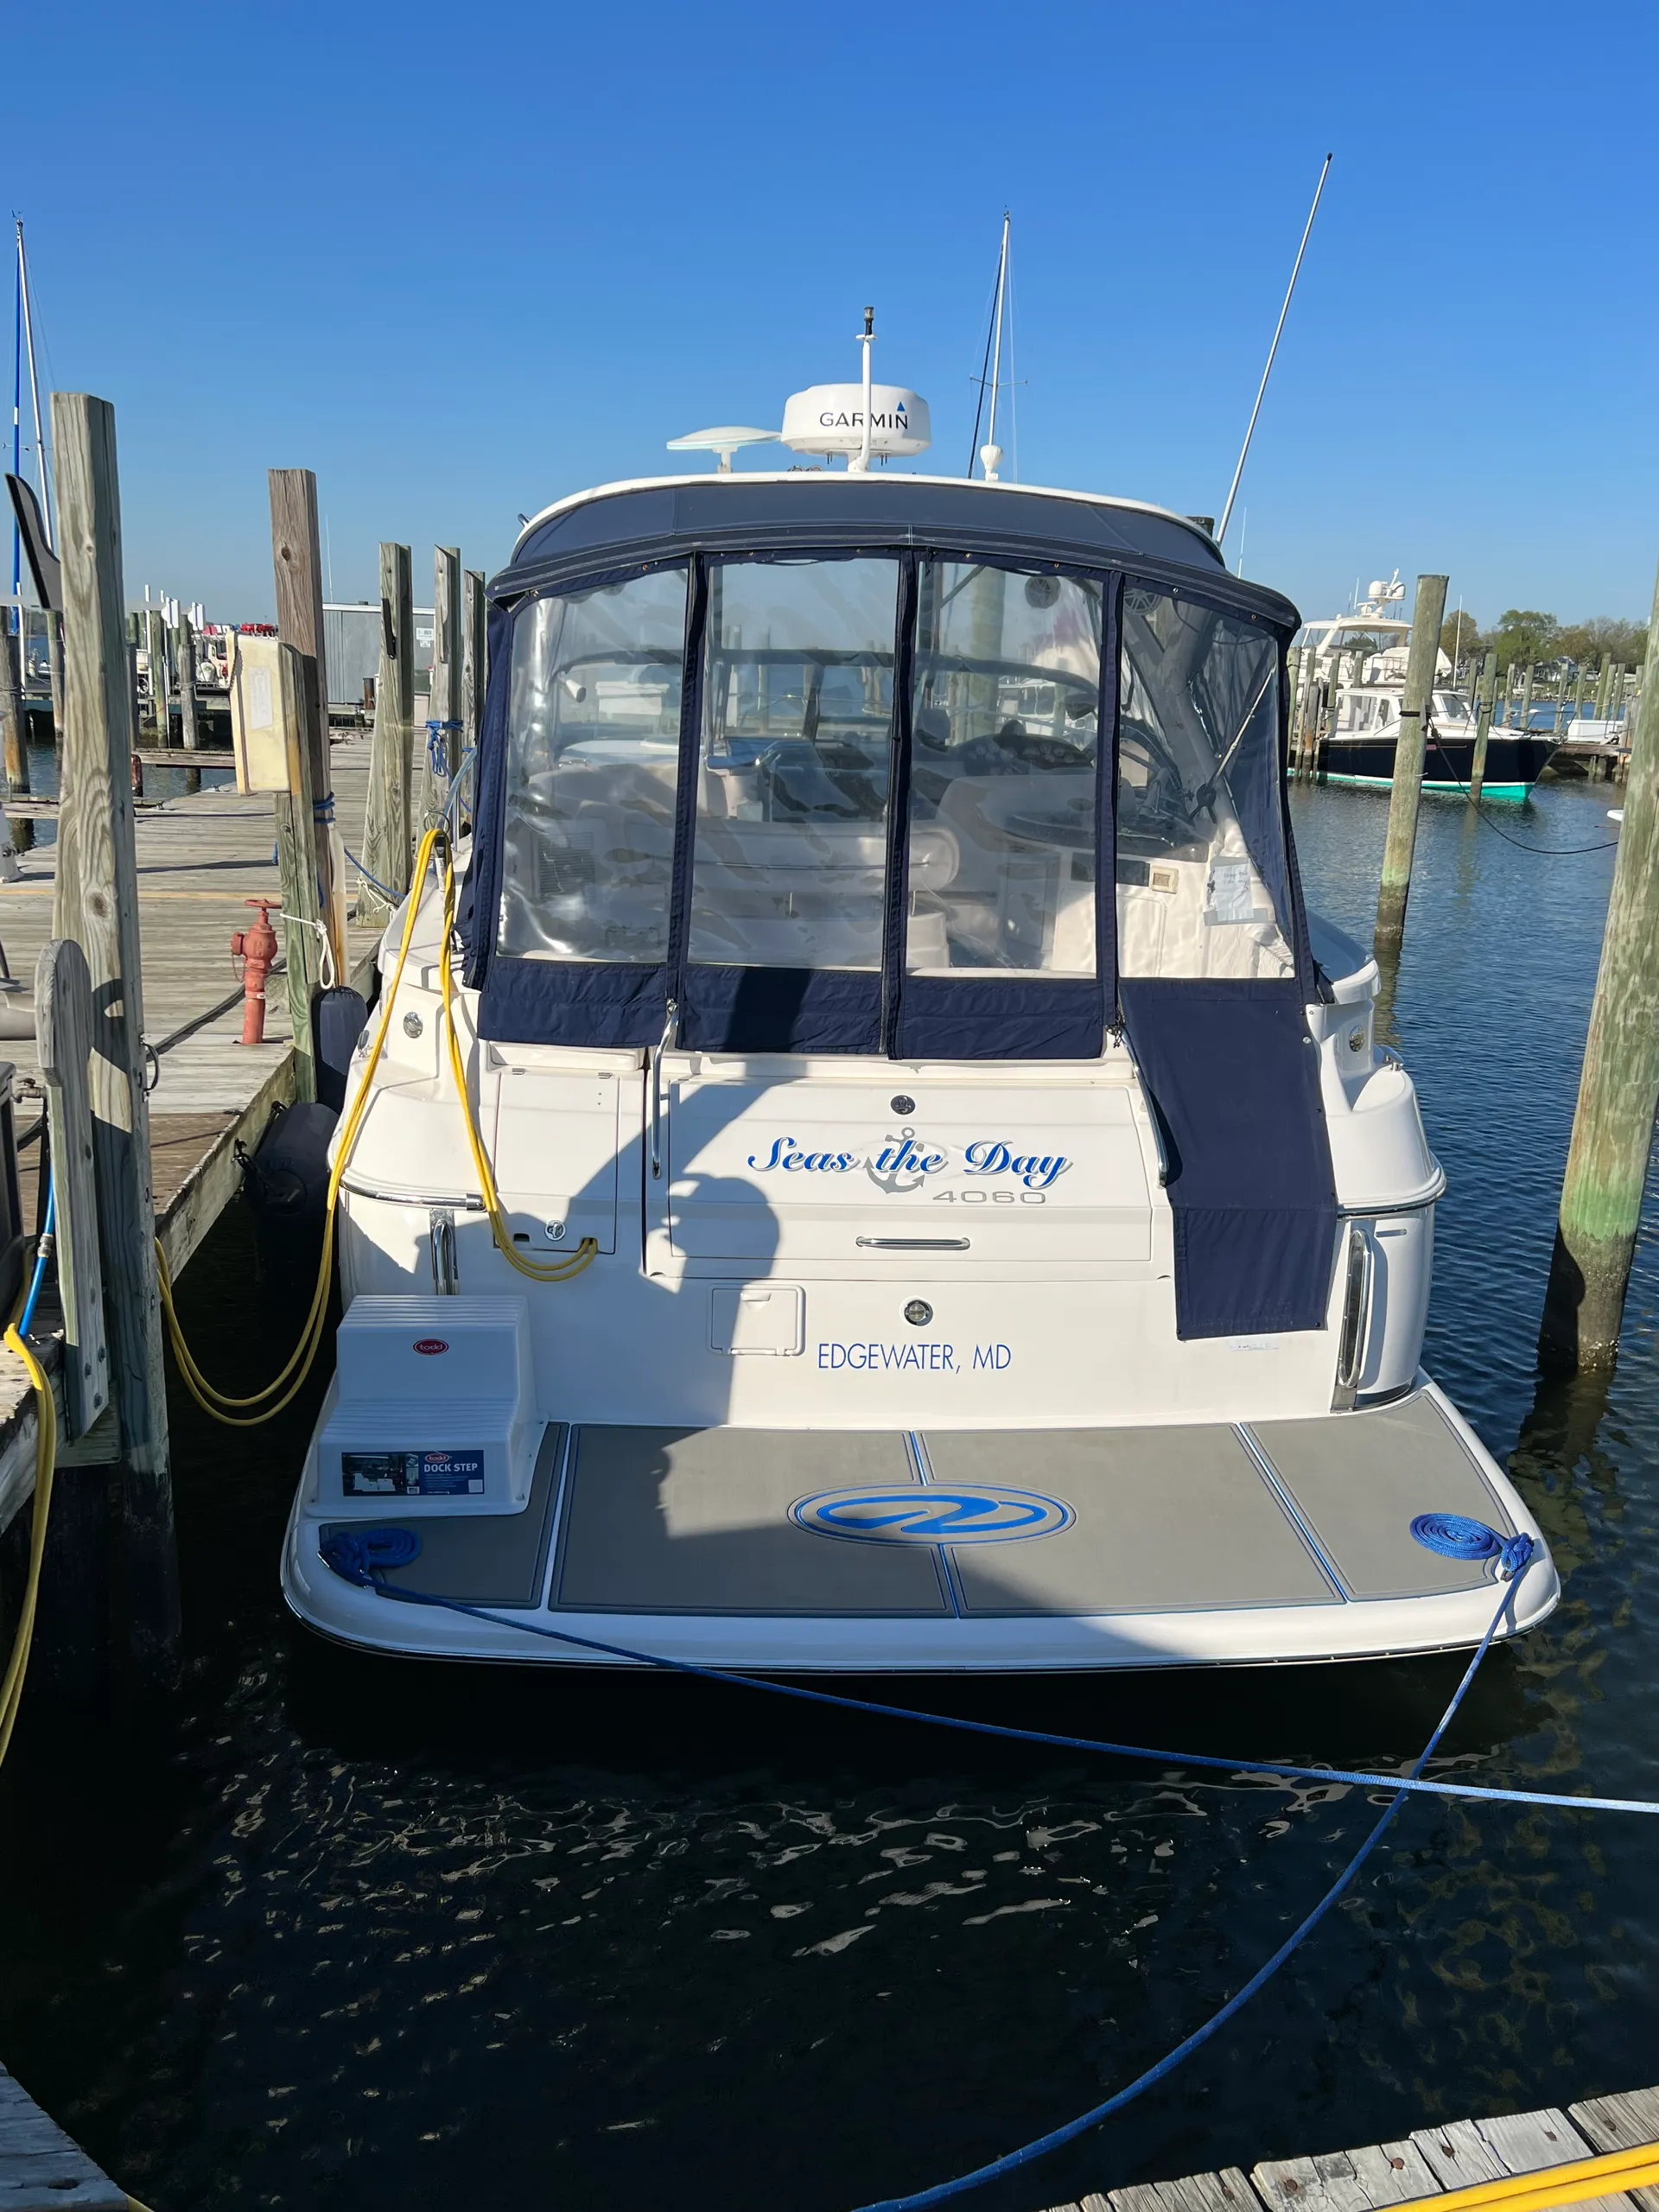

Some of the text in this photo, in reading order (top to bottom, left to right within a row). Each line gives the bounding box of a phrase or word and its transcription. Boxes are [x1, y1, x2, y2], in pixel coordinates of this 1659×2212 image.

[819, 411, 908, 429] GARMIN
[747, 1136, 1073, 1190] Seas the Day
[932, 1190, 1046, 1205] 4060
[818, 1343, 1012, 1374] EDGEWATER, MD
[423, 1462, 478, 1472] DOCK STEP
